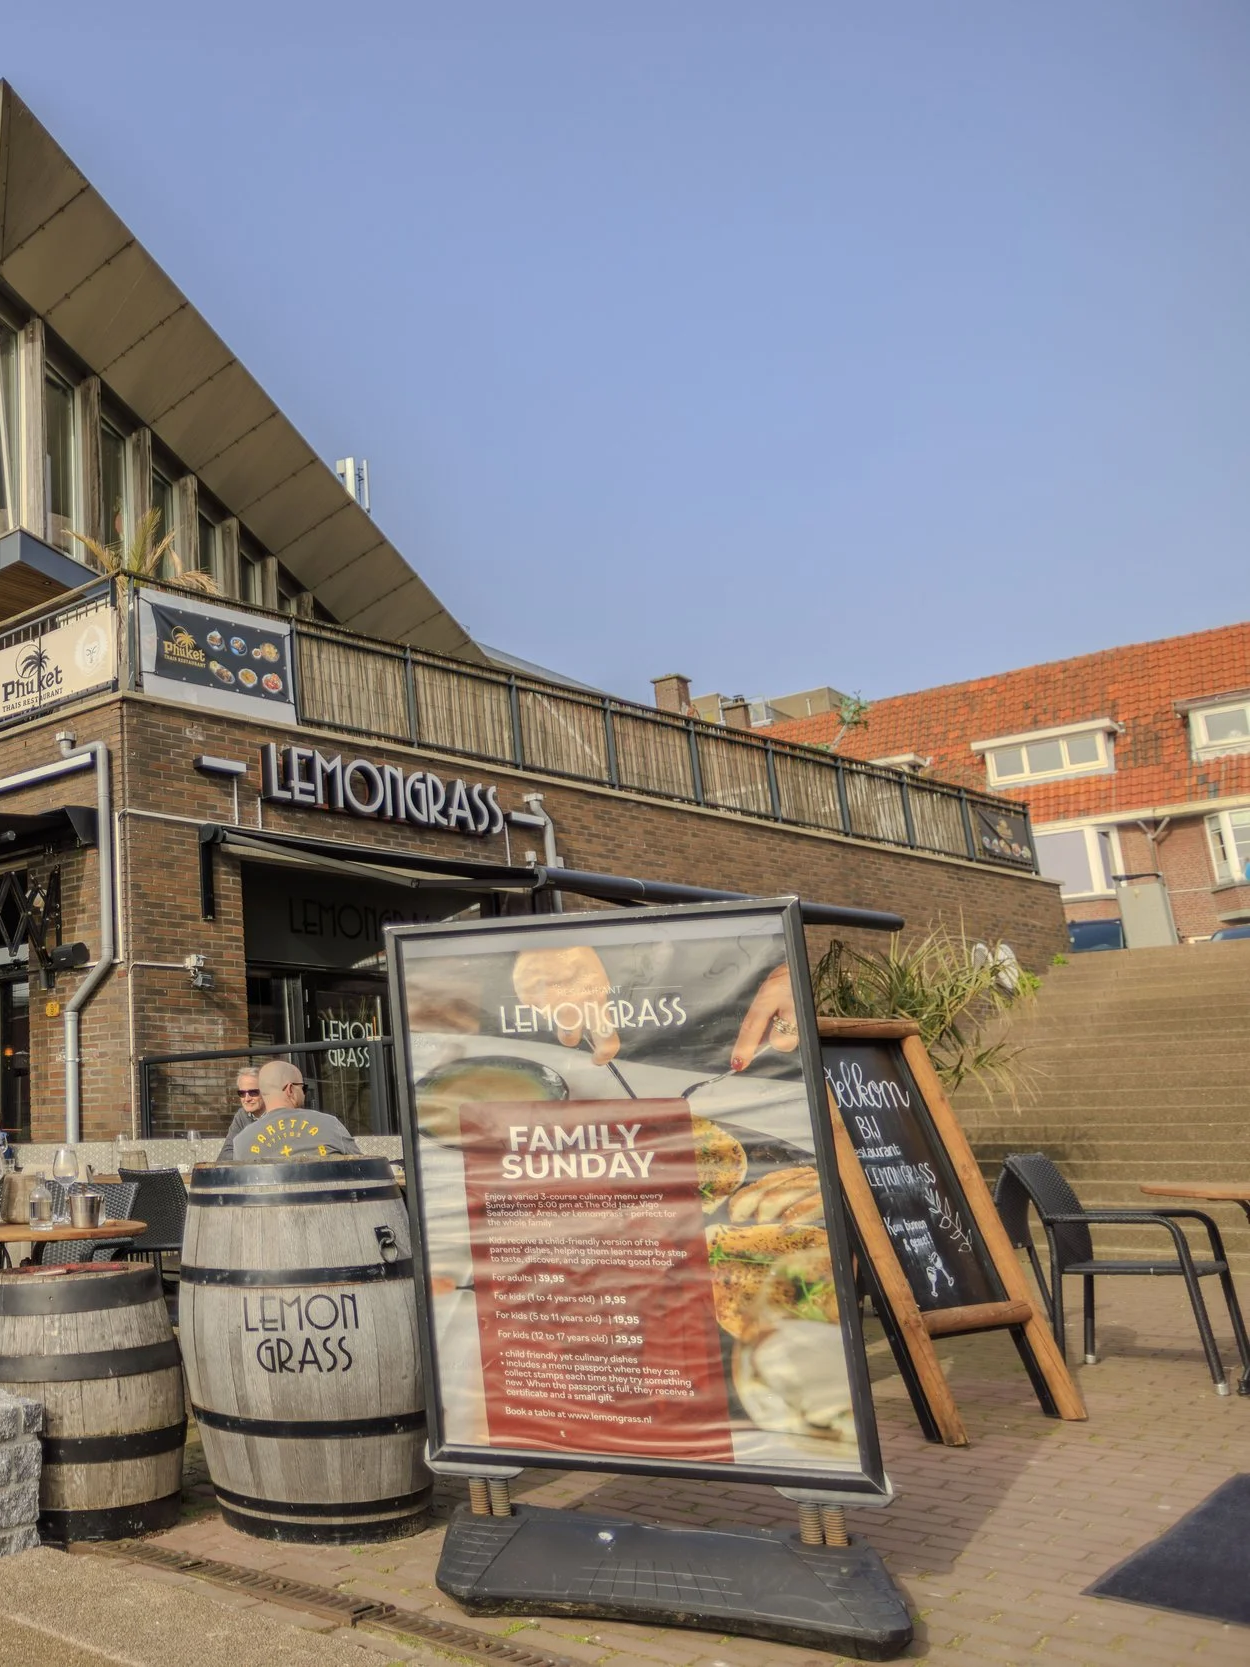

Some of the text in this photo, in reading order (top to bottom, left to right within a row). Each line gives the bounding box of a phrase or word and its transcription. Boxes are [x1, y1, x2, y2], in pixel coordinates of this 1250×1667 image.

[163, 641, 206, 662] Phuket
[2, 665, 63, 702] Phuket
[2, 688, 63, 712] THAIS RESTAURANT
[263, 742, 504, 834] LEMONGRASS
[500, 997, 686, 1033] LEMONGRASS
[321, 1020, 373, 1041] LEMON
[328, 1047, 371, 1067] GRASS
[251, 1119, 319, 1154] BARETTA
[509, 1124, 642, 1151] FAMILY
[854, 1144, 900, 1158] estaurant
[502, 1152, 655, 1179] SUNDAY
[865, 1162, 936, 1188] LEMONGRASS
[484, 1193, 506, 1202] Enjoy
[579, 1193, 612, 1202] culinary
[485, 1201, 515, 1209] Sunday
[639, 1201, 659, 1209] Vigo
[572, 1210, 623, 1219] Lemongrass
[630, 1210, 663, 1218] perfect
[545, 1237, 600, 1247] child-friendly
[644, 1239, 660, 1247] the
[554, 1247, 585, 1256] helping
[634, 1249, 653, 1257] step
[655, 1248, 666, 1257] by
[667, 1249, 687, 1258] step
[525, 1256, 562, 1264] discover,
[580, 1258, 626, 1266] appreciate
[628, 1258, 651, 1267] good
[652, 1258, 675, 1266] food.
[538, 1274, 565, 1283] 39,95
[494, 1291, 507, 1300] For
[554, 1295, 577, 1303] years
[578, 1295, 595, 1304] old)
[604, 1296, 627, 1305] 9,95
[243, 1294, 359, 1331] LEMON
[495, 1311, 509, 1319] For
[510, 1311, 527, 1319] kids
[529, 1312, 538, 1322] (5
[560, 1315, 583, 1323] years
[584, 1315, 602, 1325] old)
[613, 1315, 640, 1325] 19,95
[498, 1330, 511, 1338] For
[512, 1331, 529, 1339] kids
[531, 1332, 544, 1341] (12
[567, 1335, 590, 1343] years
[591, 1335, 608, 1344] old)
[615, 1335, 643, 1345] 29,95
[257, 1336, 352, 1373] GRASS
[505, 1350, 638, 1364] child friendly yet culinary dishes
[506, 1360, 540, 1368] includes
[574, 1364, 612, 1373] passport
[613, 1365, 641, 1374] where
[642, 1366, 662, 1376] they
[504, 1369, 692, 1388] collect stamps each time they try something
[505, 1379, 525, 1387] new.
[526, 1380, 551, 1388] When
[552, 1381, 567, 1389] the
[568, 1384, 606, 1393] passport
[607, 1384, 615, 1392] is
[616, 1384, 632, 1394] full,
[634, 1385, 653, 1396] they
[655, 1388, 688, 1396] receive
[506, 1388, 548, 1398] certificate
[550, 1391, 566, 1399] and
[574, 1393, 597, 1401] small
[598, 1394, 615, 1403] gift.
[505, 1406, 526, 1415] Book
[534, 1409, 556, 1417] table
[567, 1412, 652, 1424] www.lemongrass.nl
